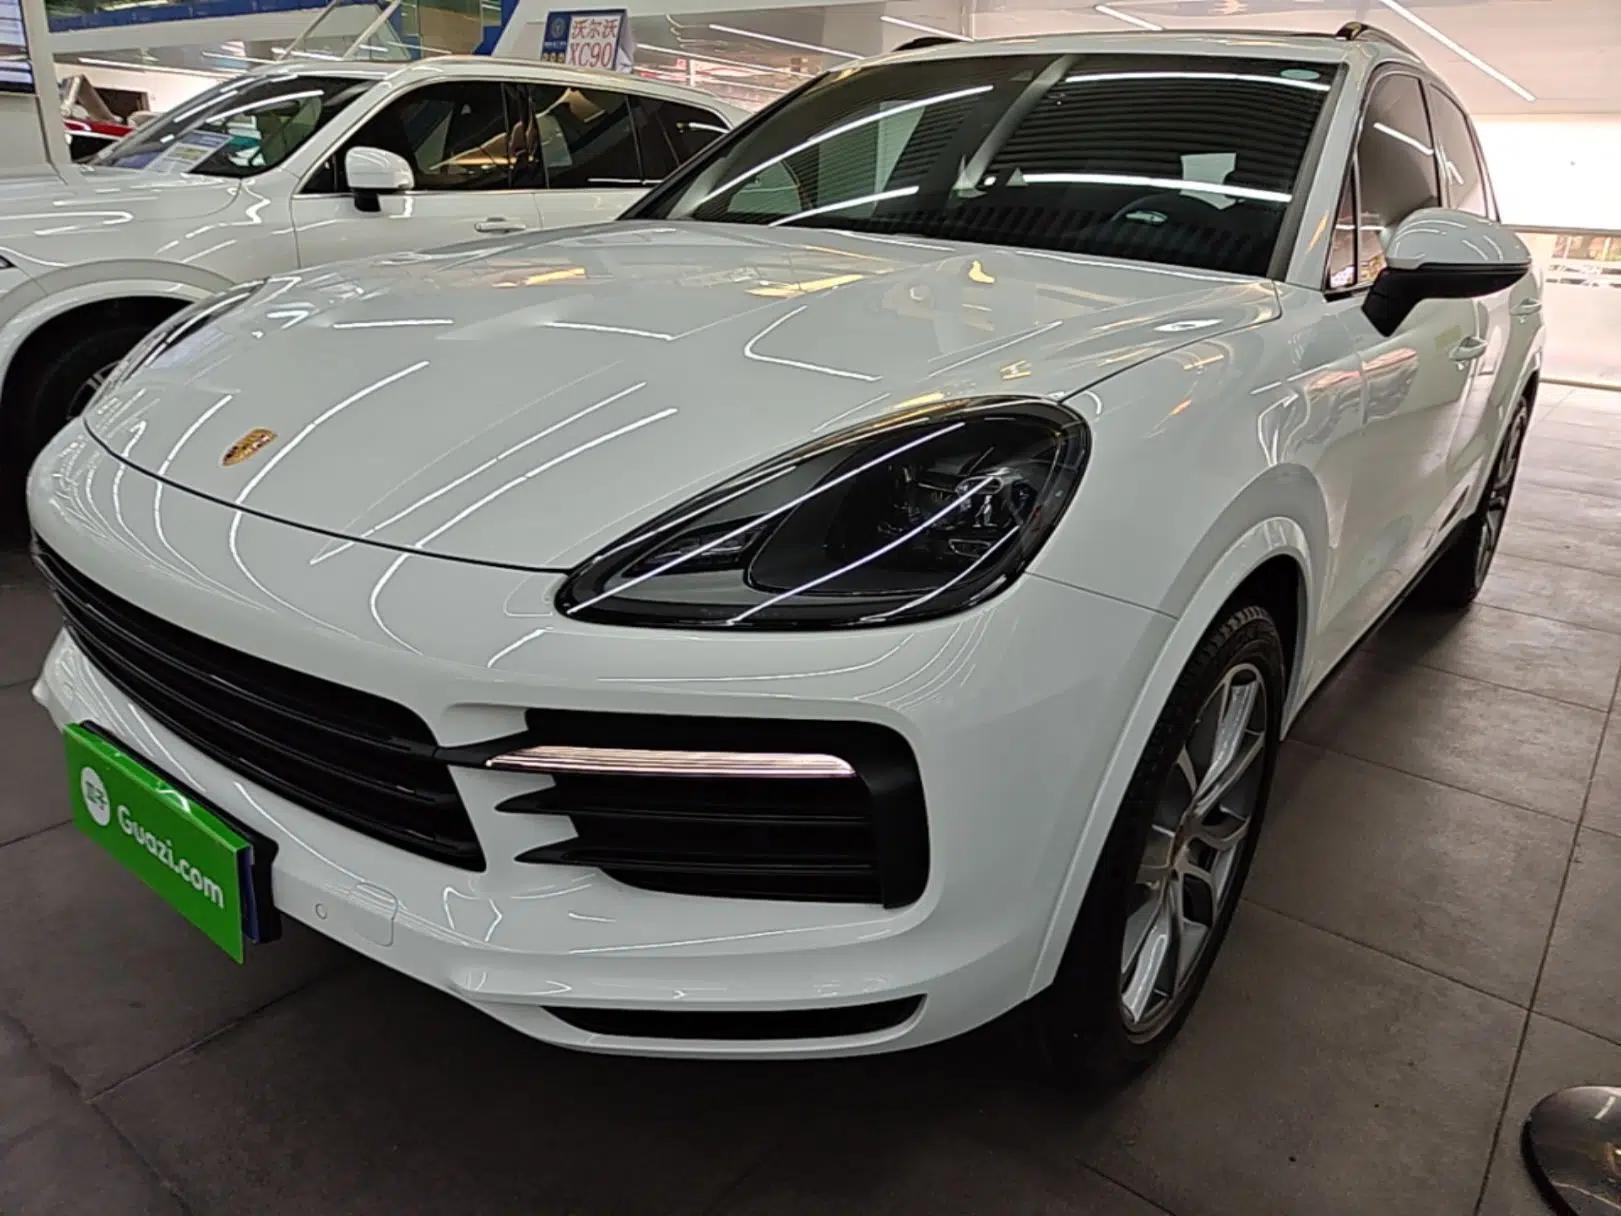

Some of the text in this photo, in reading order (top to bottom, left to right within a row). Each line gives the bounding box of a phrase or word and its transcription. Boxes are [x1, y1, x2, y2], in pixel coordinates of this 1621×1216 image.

[571, 18, 618, 40] 沃尔沃
[569, 42, 613, 67] XC90
[117, 804, 224, 909] Guazi.com
